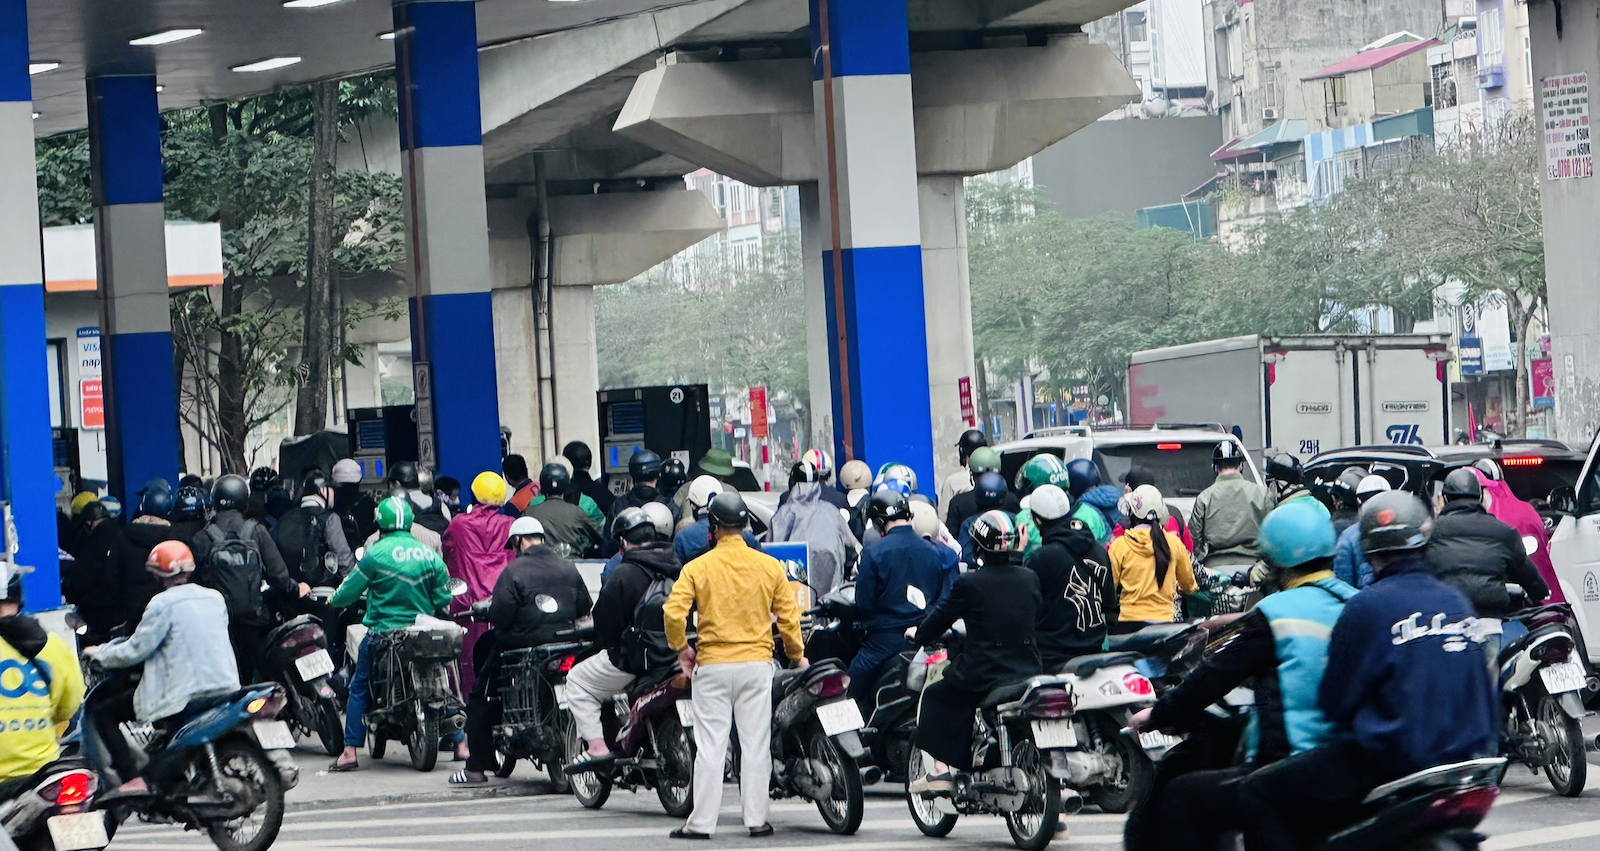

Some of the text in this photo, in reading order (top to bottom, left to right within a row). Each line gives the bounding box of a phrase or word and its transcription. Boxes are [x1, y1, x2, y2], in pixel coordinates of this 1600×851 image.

[83, 343, 100, 352] VIS
[672, 391, 681, 400] 21
[391, 544, 435, 563] Grab
